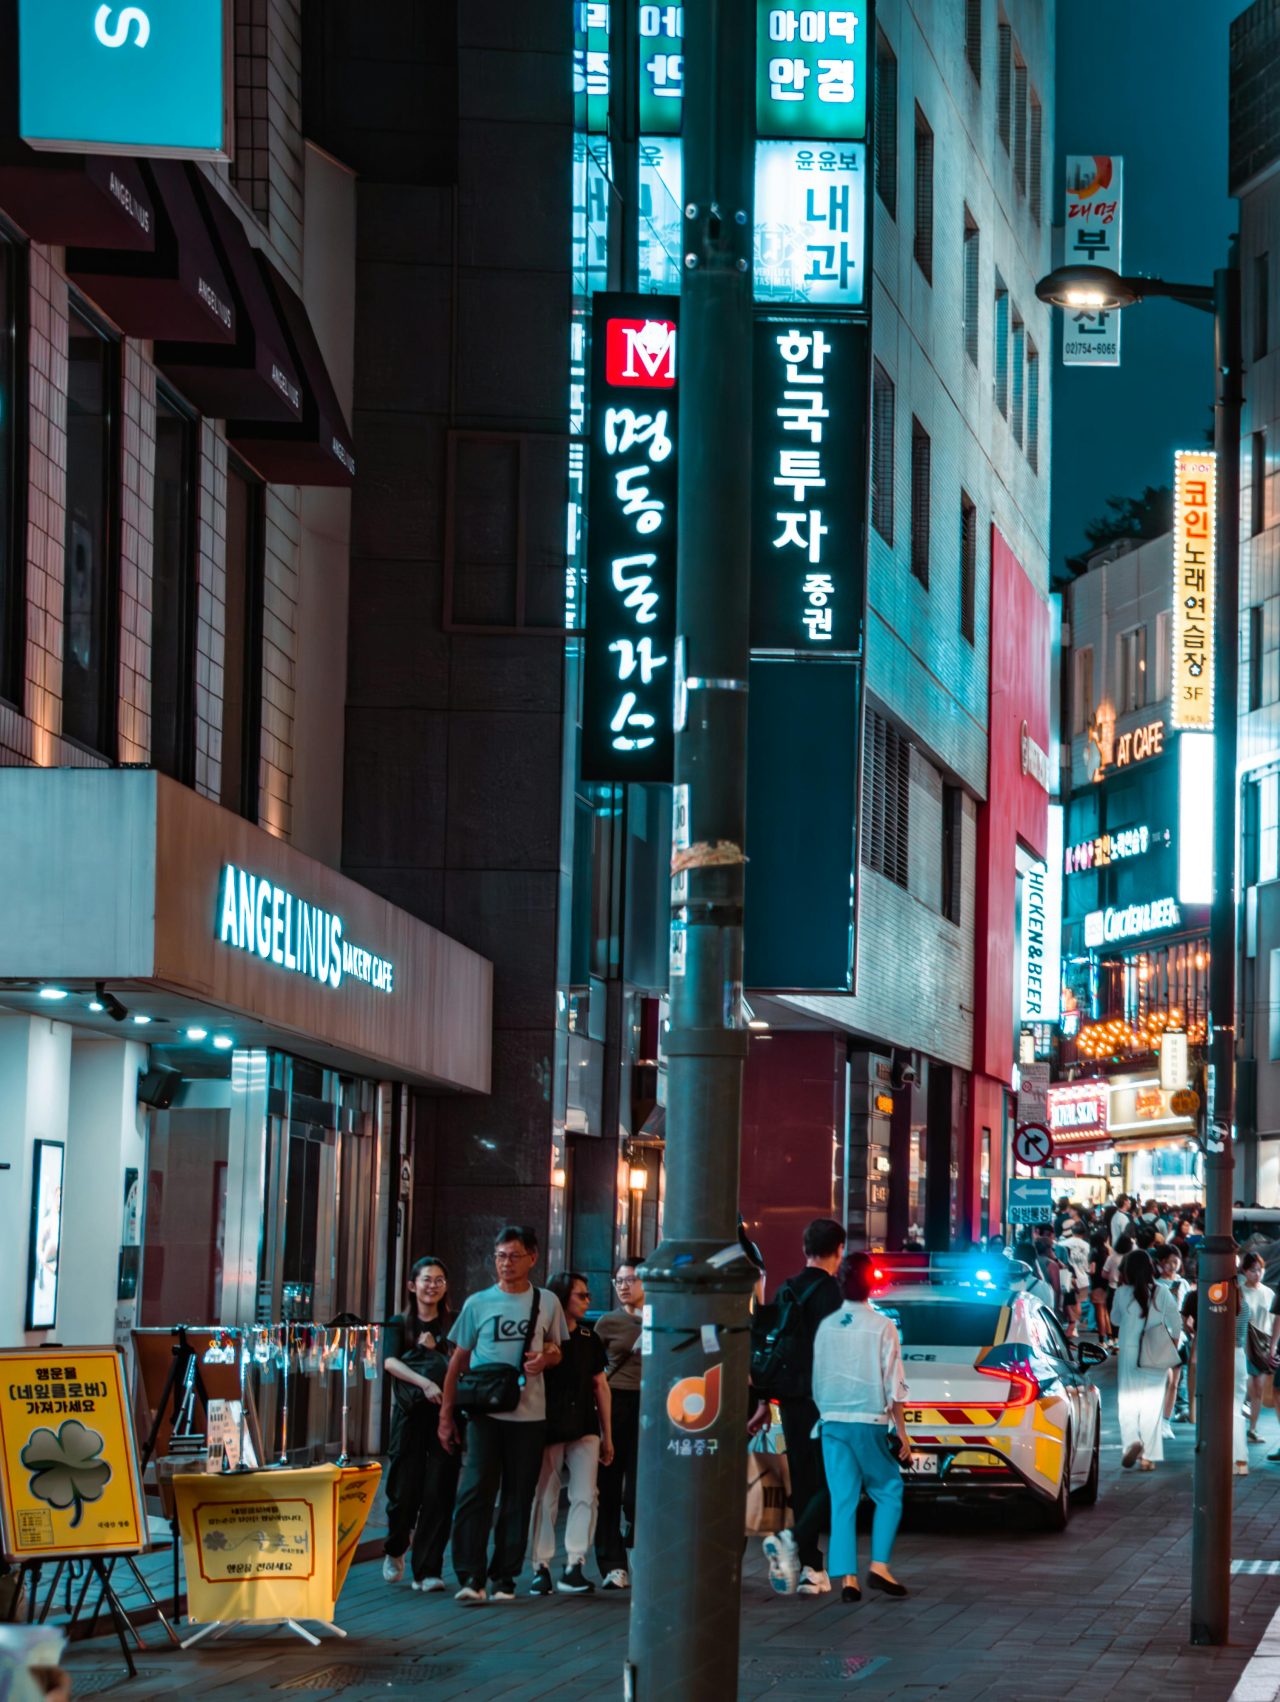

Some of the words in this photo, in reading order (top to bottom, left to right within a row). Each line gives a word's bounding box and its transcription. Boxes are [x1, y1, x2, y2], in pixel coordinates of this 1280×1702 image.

[768, 10, 858, 43] 아이닥
[768, 58, 855, 102] 안경
[1068, 201, 1117, 224] 대명
[804, 185, 855, 289] 내과
[1073, 229, 1110, 334] 부산
[772, 329, 832, 564] 한국투자
[803, 573, 835, 641] 증권
[1183, 480, 1208, 677] 코인노래연습장
[1183, 685, 1203, 700] 3F
[1133, 720, 1164, 761] CAFE
[221, 864, 342, 988] ANGELINUS
[371, 955, 392, 993] CAFE
[1011, 1206, 1050, 1222] 일방통행
[494, 1314, 530, 1342] Lee
[36, 1367, 77, 1380] 행운을
[902, 1353, 937, 1362] ICE
[667, 1439, 718, 1456] 서울중구
